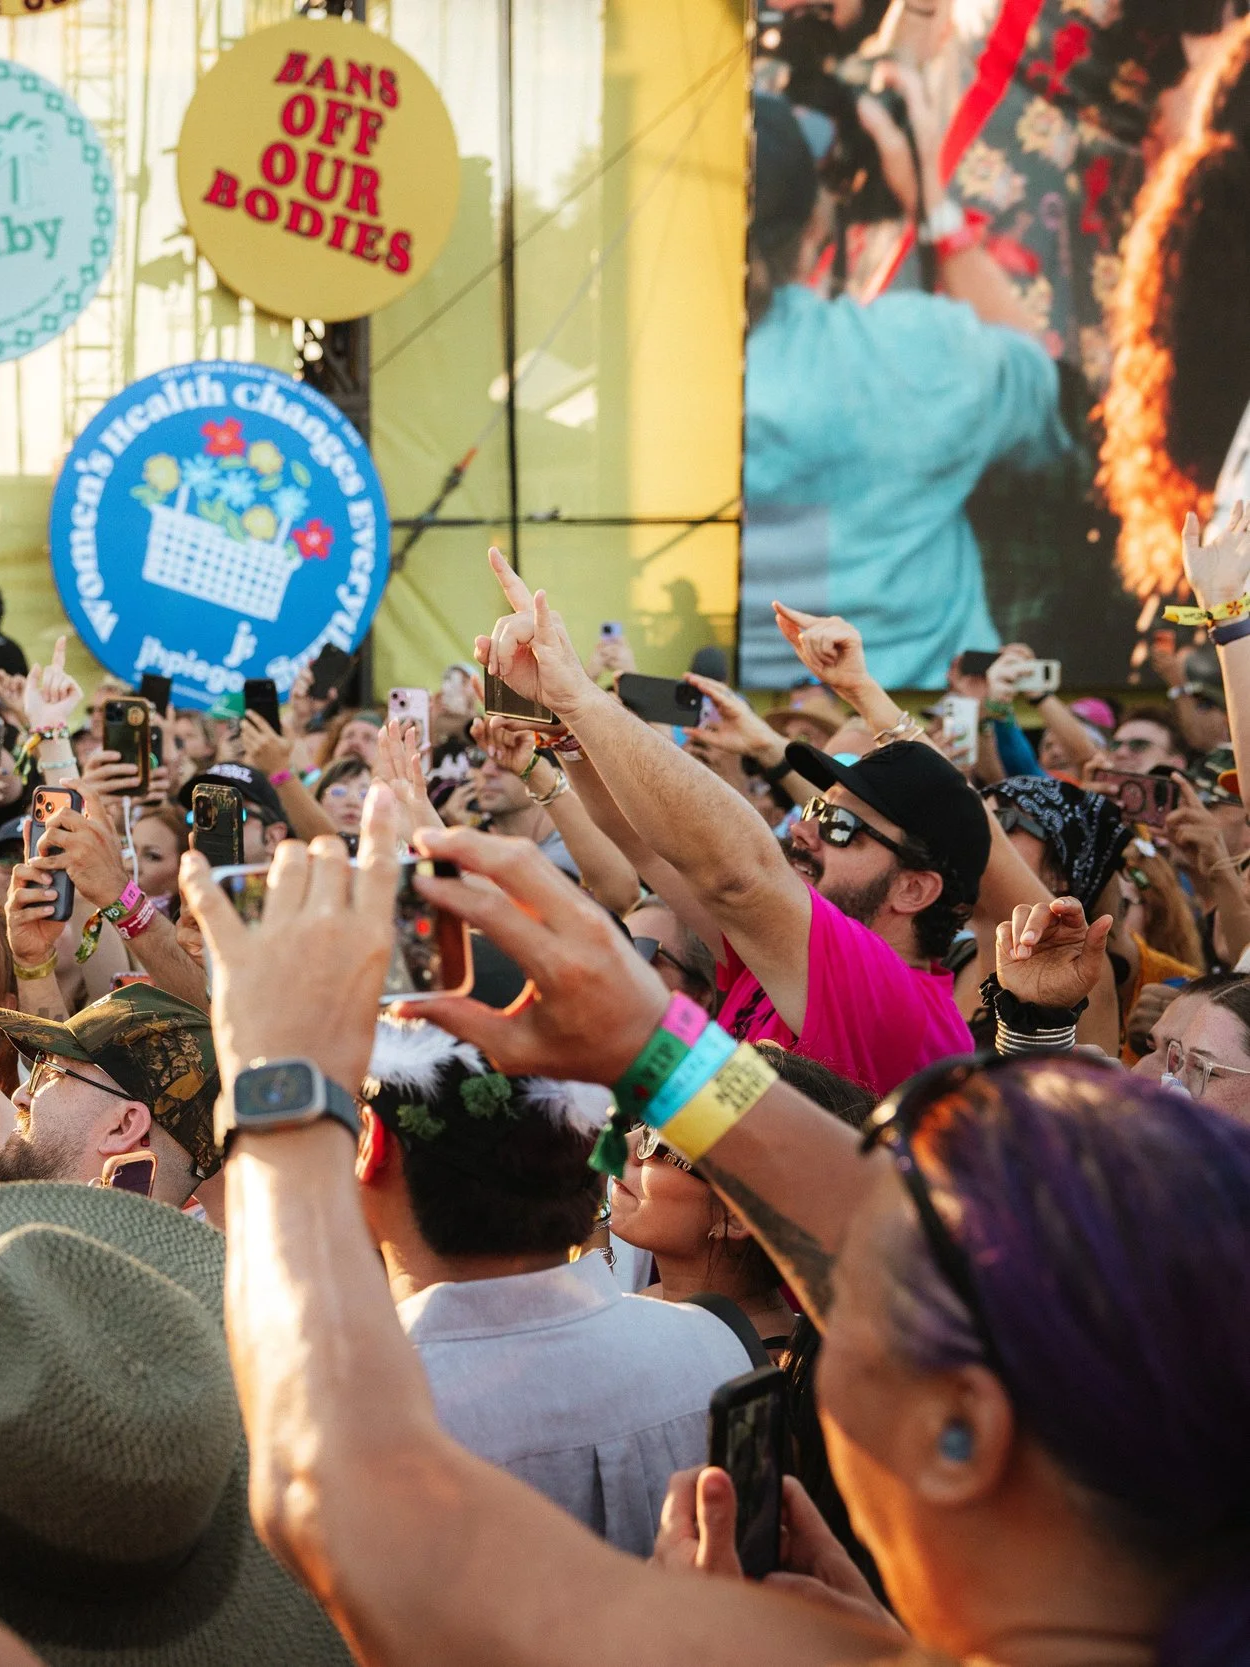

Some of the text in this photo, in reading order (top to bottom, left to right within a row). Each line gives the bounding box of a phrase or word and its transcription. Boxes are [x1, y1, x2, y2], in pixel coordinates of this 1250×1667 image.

[274, 51, 400, 109] BANS
[280, 93, 383, 157] OFF
[260, 142, 380, 217] OUR
[203, 170, 412, 274] BODIES
[98, 374, 228, 457] Health
